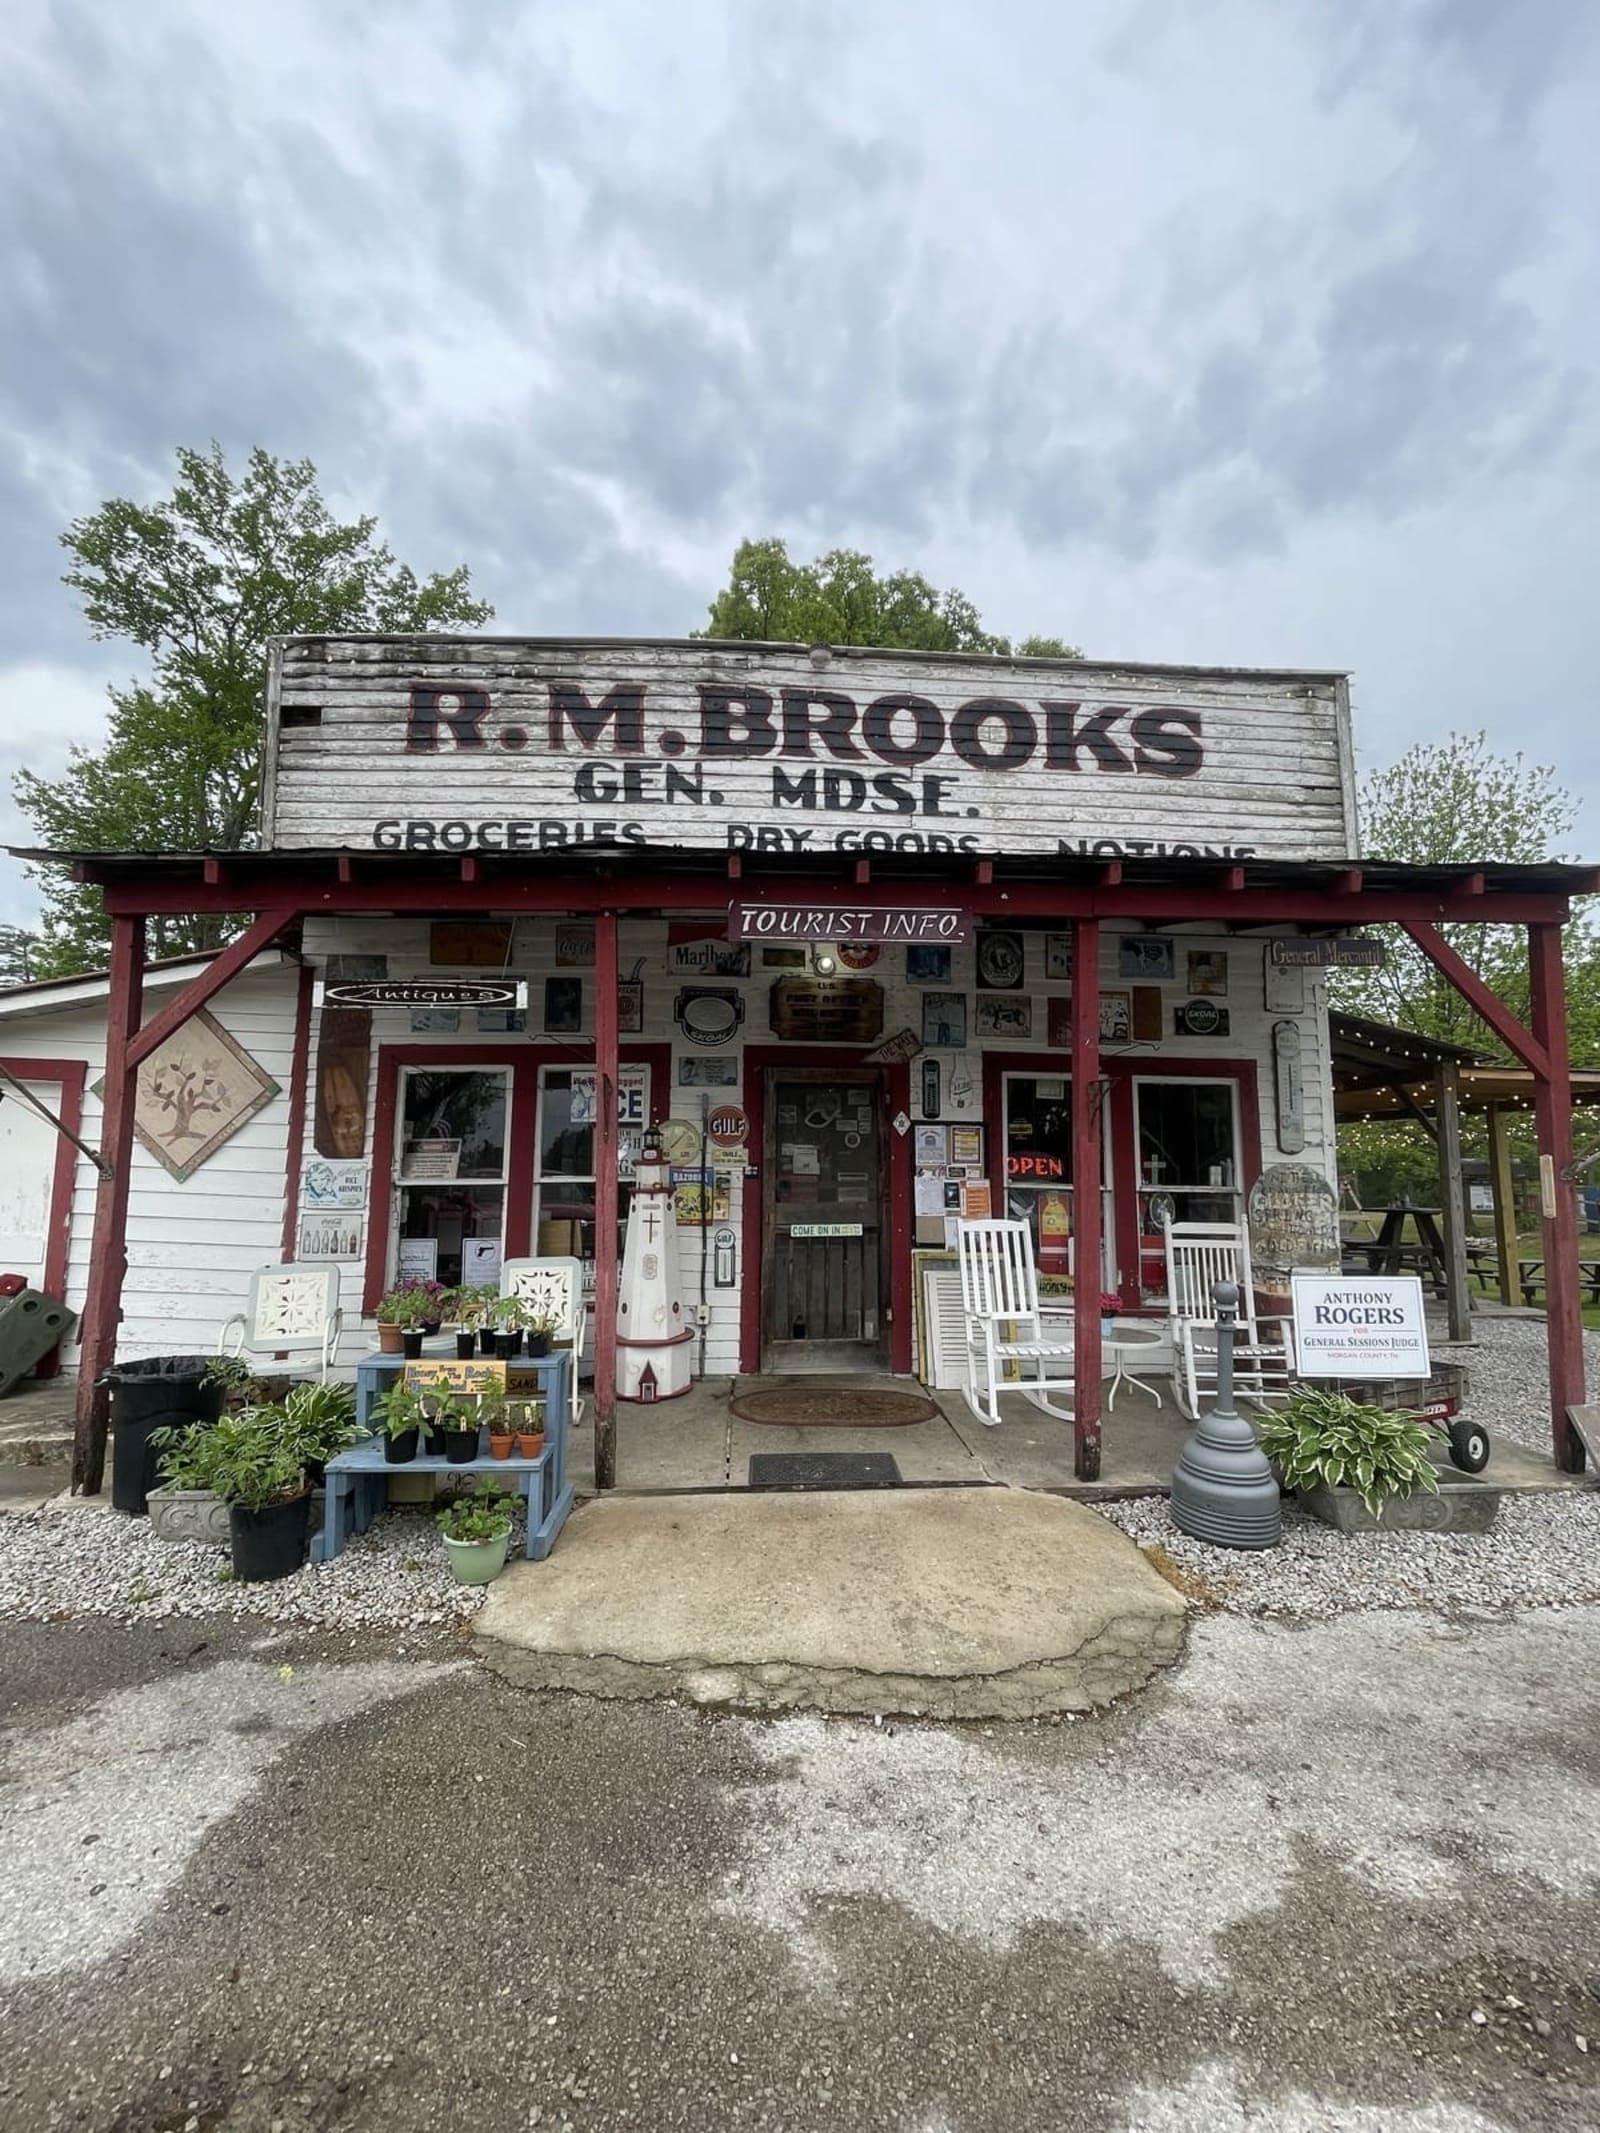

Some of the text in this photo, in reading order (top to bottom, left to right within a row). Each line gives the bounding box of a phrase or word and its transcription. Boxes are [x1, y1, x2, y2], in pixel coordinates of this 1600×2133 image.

[574, 762, 980, 818] GEN. MDSE.
[740, 909, 873, 934] TOURIST
[340, 986, 495, 1002] Antiques
[712, 1117, 745, 1136] GULF
[1006, 1156, 1063, 1177] OPEN
[793, 1226, 814, 1236] COME
[832, 1225, 841, 1235] IN
[1323, 1292, 1393, 1305] ANTHONY
[1315, 1305, 1404, 1325] ROGERS
[1303, 1336, 1420, 1349] GENERAL SESSIONS JUDGE
